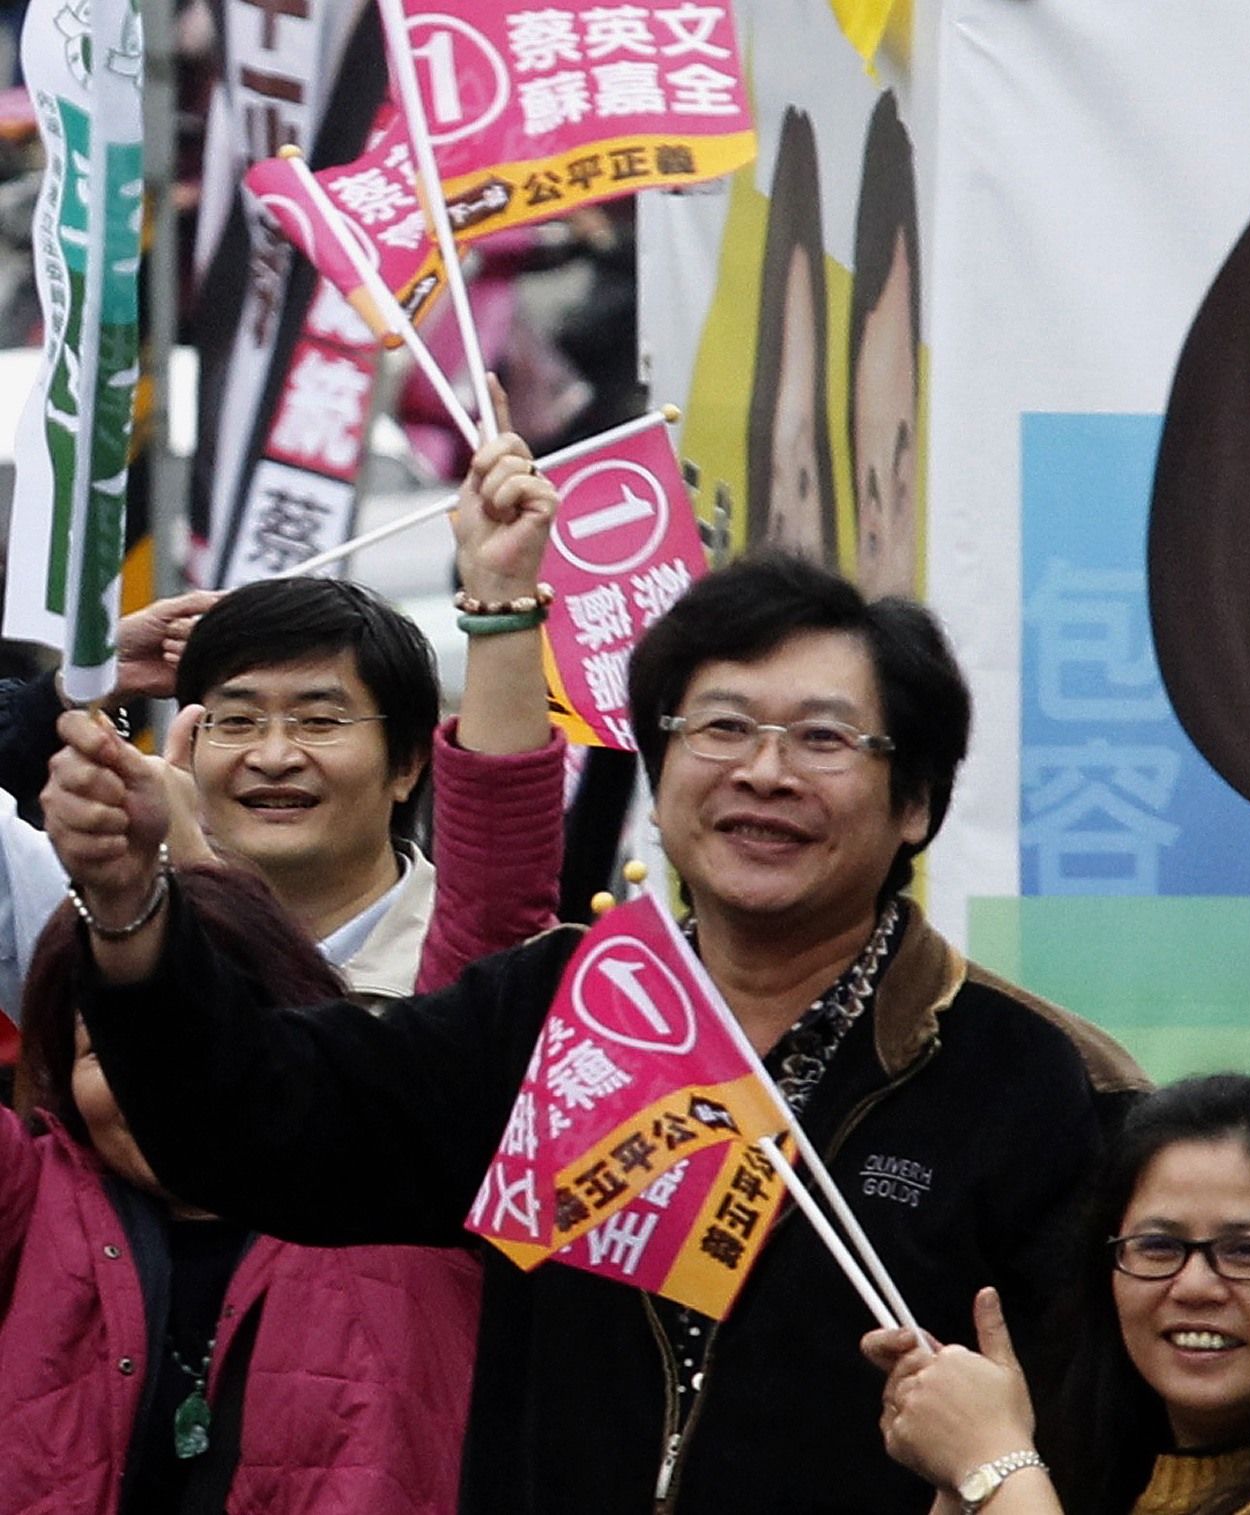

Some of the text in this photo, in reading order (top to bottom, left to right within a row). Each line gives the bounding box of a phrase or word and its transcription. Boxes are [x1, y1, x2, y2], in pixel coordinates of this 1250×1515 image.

[505, 2, 733, 73] 蔡英文
[517, 60, 741, 136] 蘇嘉全
[524, 145, 697, 207] 公平正義
[1021, 556, 1184, 896] 包容
